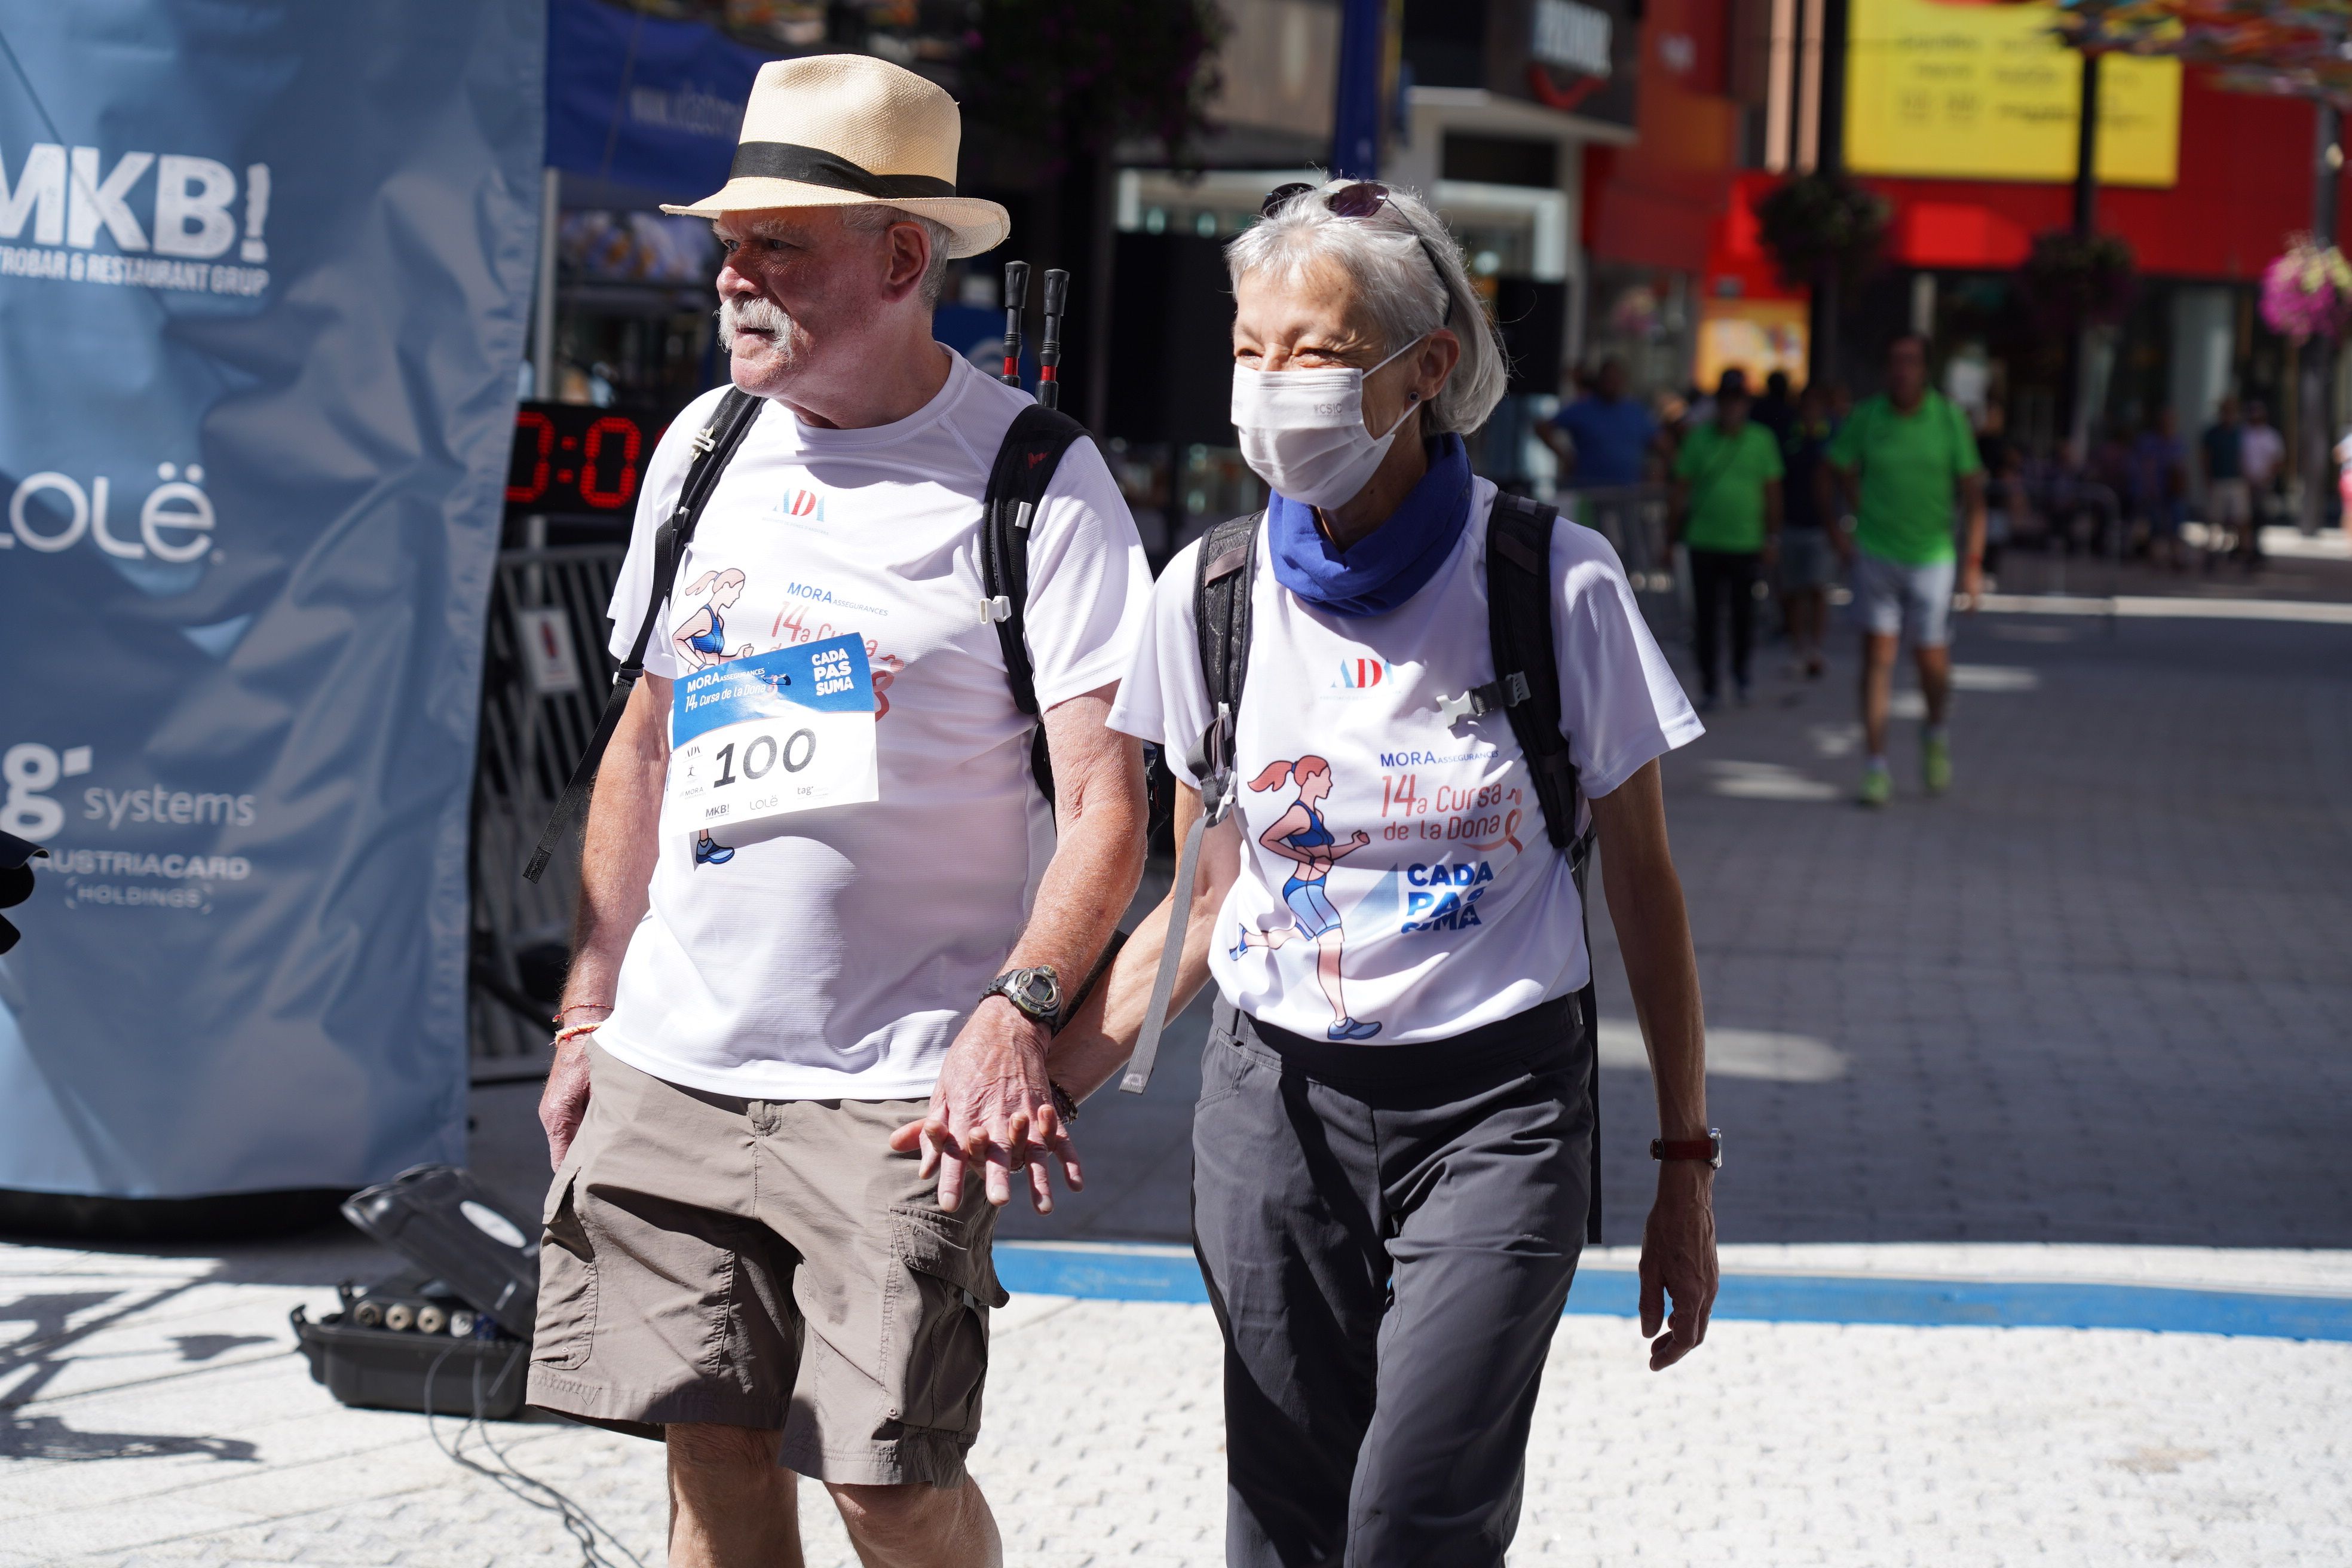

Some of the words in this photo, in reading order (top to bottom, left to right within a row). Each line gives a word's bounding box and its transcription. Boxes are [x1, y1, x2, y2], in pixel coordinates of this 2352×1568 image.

[0, 143, 271, 264] MKB!
[87, 253, 210, 292] RESTAURANT
[210, 266, 271, 296] GRUP
[0, 461, 217, 563] OLë
[787, 582, 832, 604] MORA
[833, 599, 889, 616] ASSEGURANCES
[811, 648, 849, 666] CADA
[687, 672, 720, 693] MORA
[720, 667, 765, 682] ASSEGURANCES
[813, 661, 852, 681] PAS
[700, 692, 719, 706] Cursa
[721, 688, 731, 700] de
[734, 687, 742, 697] la
[744, 684, 765, 696] Dona
[816, 676, 854, 696] SUMA
[713, 728, 816, 788] 100
[1381, 751, 1436, 766] MORA
[1438, 750, 1499, 764] ASSEGURANCES
[685, 786, 703, 796] MORA
[1437, 783, 1501, 812] Cursa
[84, 783, 256, 831] systems
[706, 804, 729, 817] MKB!
[1384, 821, 1409, 840] de
[1420, 820, 1442, 840] la
[1447, 814, 1500, 840] Dona
[30, 849, 252, 880] AUSTRIACARD
[1407, 860, 1493, 886] CADA
